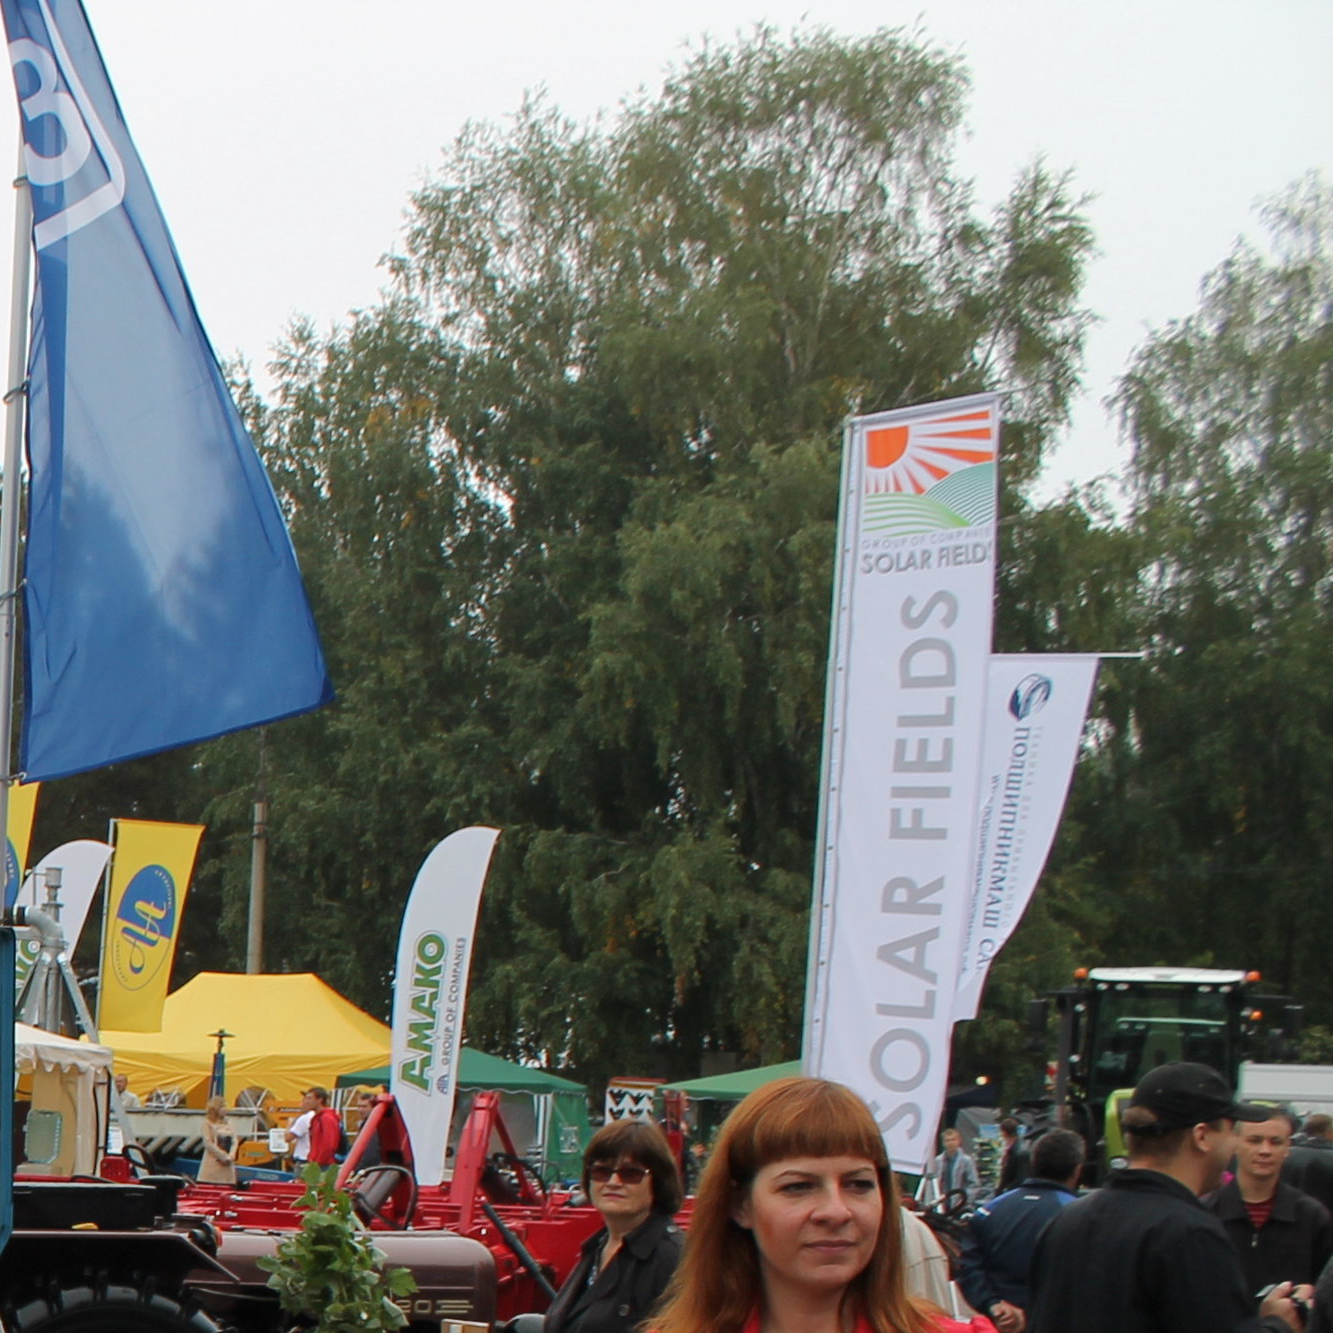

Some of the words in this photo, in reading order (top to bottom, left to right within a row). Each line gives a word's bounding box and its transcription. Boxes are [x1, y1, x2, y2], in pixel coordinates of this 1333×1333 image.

[860, 551, 932, 575] SOLAR
[888, 589, 960, 841] FIELDS
[448, 937, 467, 1004] COMPANIES
[399, 931, 447, 1096] AMAKO
[445, 1007, 458, 1024] OF
[869, 875, 945, 1141] SOLAR
[441, 1028, 454, 1066] GROUP
